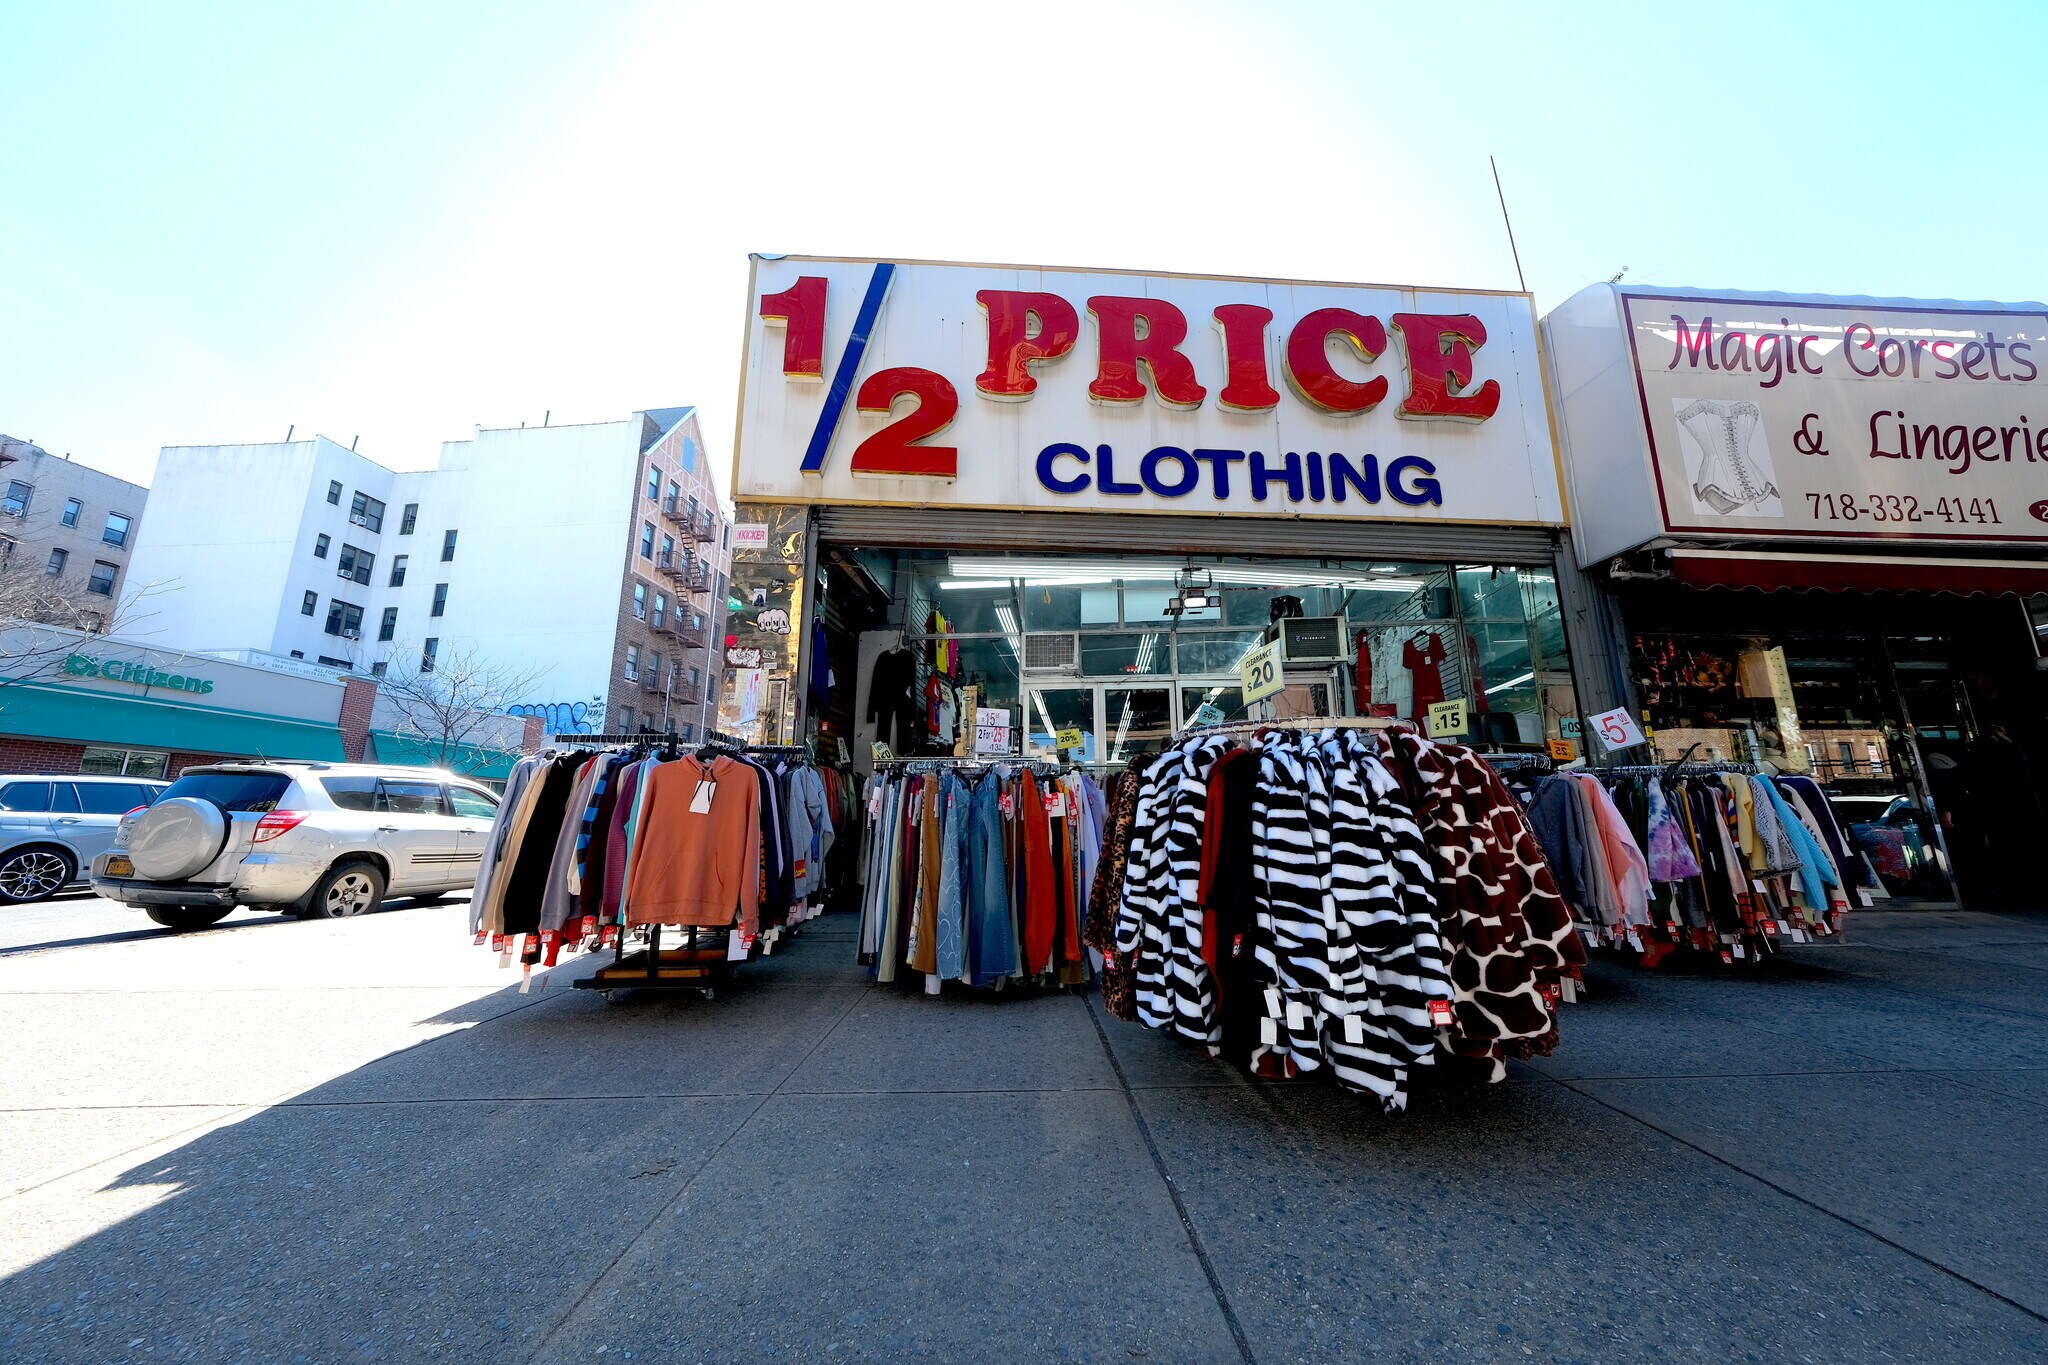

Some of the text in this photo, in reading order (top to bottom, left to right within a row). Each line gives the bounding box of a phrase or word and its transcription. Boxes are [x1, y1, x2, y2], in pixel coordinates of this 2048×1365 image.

[975, 288, 1501, 424] PRICE
[1668, 314, 2038, 388] Magic Corsets
[1793, 412, 1829, 456] &
[1036, 441, 1443, 507] CLOTHING
[1805, 493, 2002, 525] 718-332-4141
[1245, 648, 1272, 669] CLEARANCE
[101, 660, 213, 694] Citizens
[1247, 660, 1274, 692] $20
[1434, 703, 1460, 713] CLEARANCE
[1435, 712, 1461, 731] $15
[978, 729, 983, 739] 2
[1060, 734, 1077, 743] 20%
